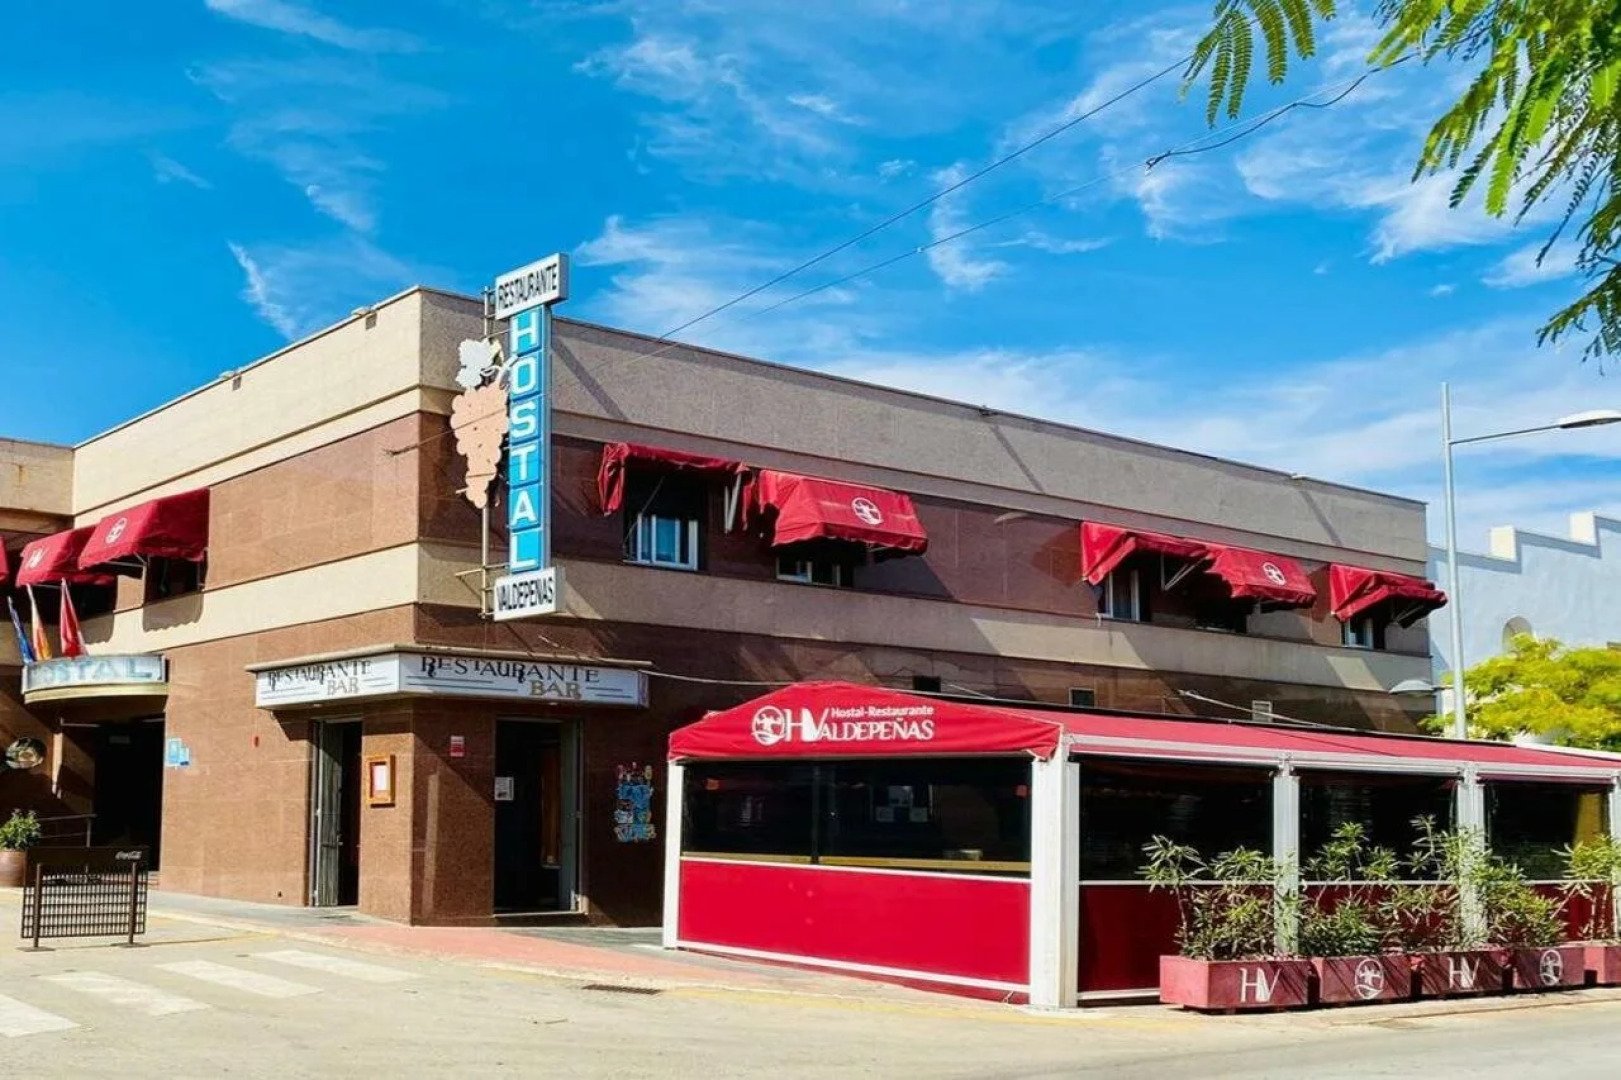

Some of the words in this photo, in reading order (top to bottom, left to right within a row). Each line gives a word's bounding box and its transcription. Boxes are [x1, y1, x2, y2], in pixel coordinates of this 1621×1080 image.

[499, 263, 557, 309] RESTAURANTE
[509, 308, 538, 569] HOSTAL
[267, 660, 372, 692] RESTAURANTE
[421, 656, 600, 684] RESTAURANTE
[327, 677, 359, 696] BAR
[529, 679, 582, 700] BAR
[831, 705, 935, 719] Hostal-Restaurante
[1240, 967, 1280, 1003] HV
